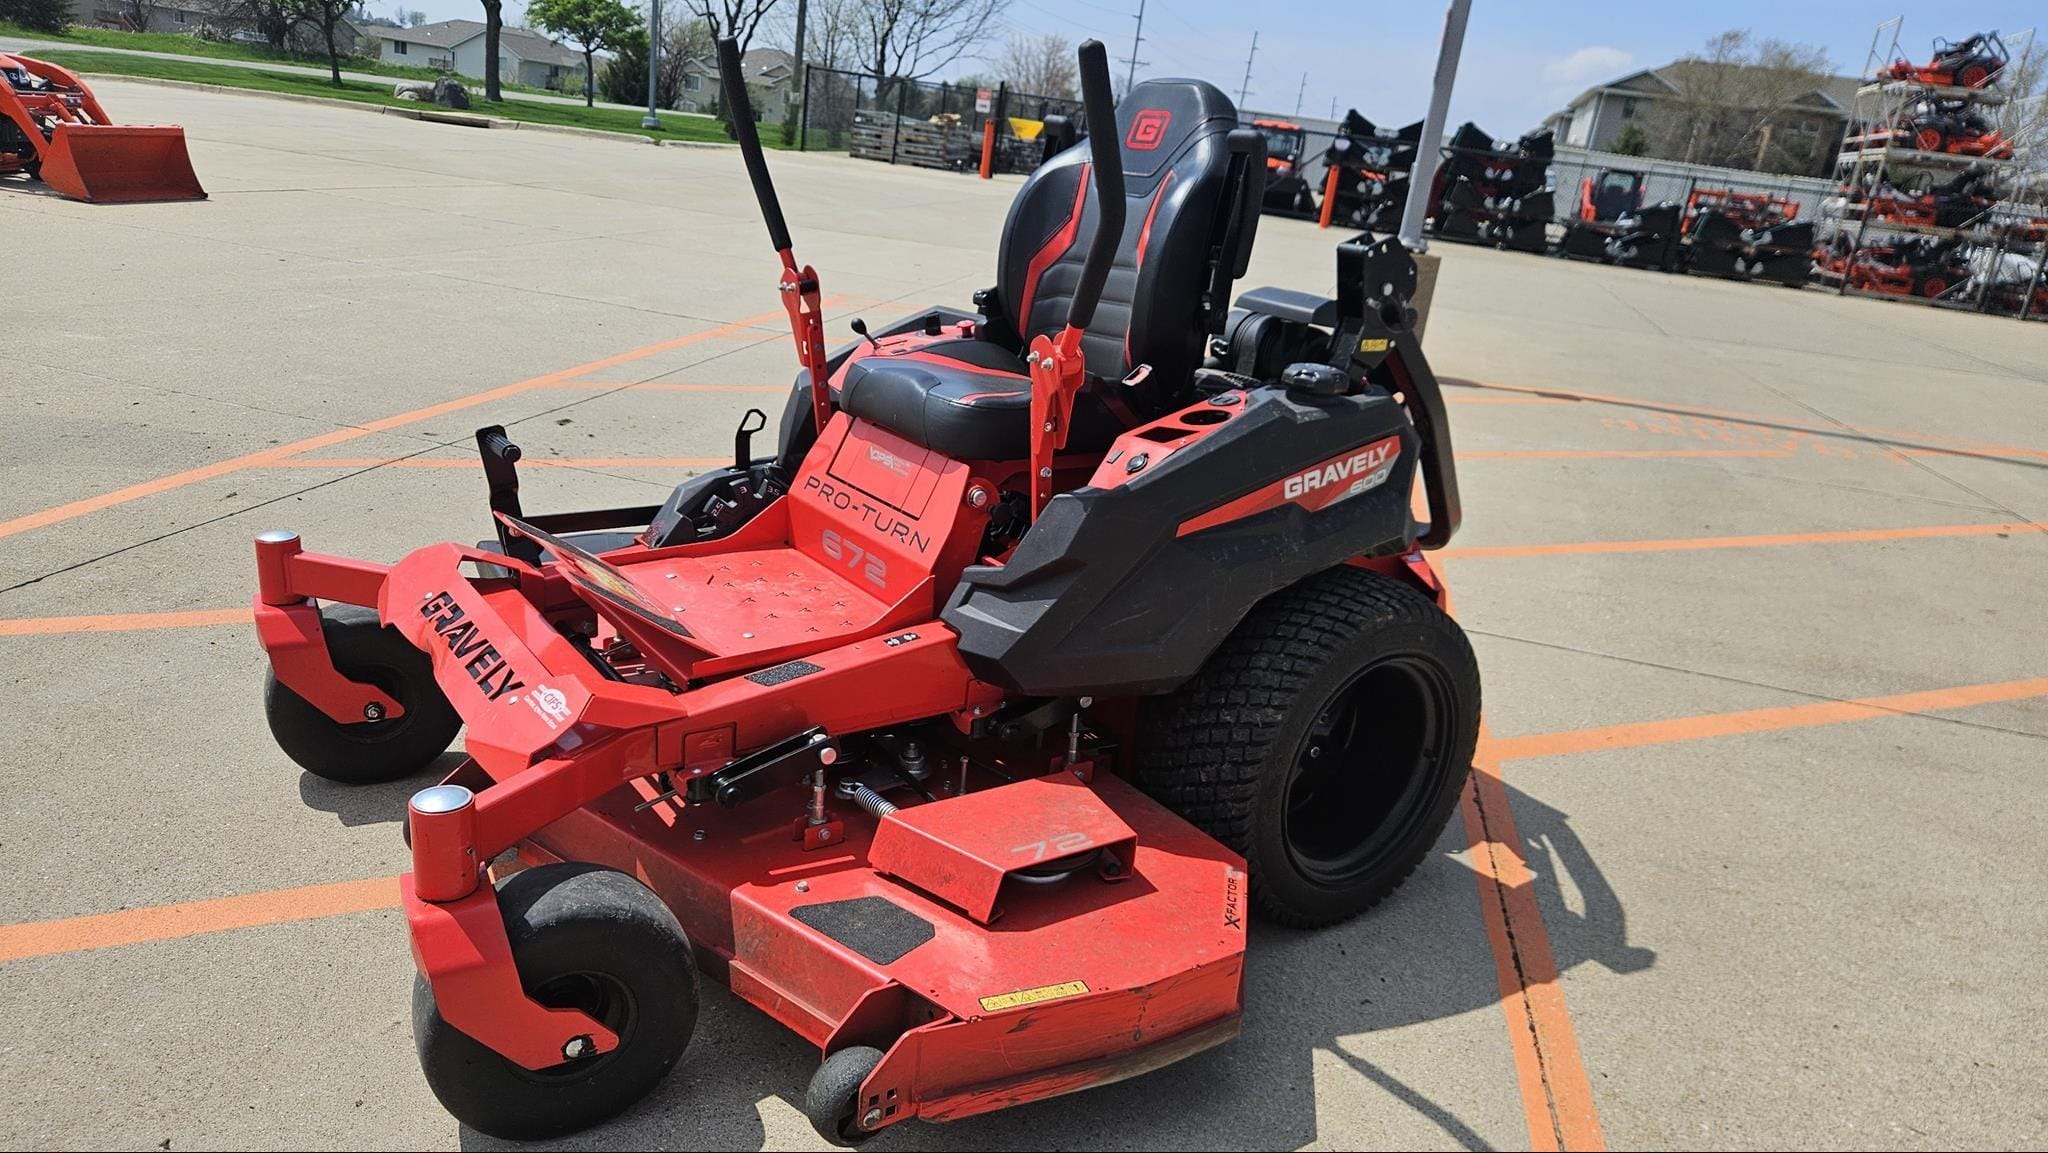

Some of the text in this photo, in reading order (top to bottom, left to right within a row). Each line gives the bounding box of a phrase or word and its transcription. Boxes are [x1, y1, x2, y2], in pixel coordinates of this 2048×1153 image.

[739, 486, 748, 494] 3
[1284, 442, 1392, 499] GRAVELY
[1350, 468, 1387, 494] 600
[804, 475, 930, 553] PRO-TURN
[822, 529, 887, 589] 672
[420, 591, 525, 702] GRAVELY
[543, 692, 562, 711] CIFS
[1010, 832, 1095, 860] 72
[1224, 877, 1241, 930] X-FACTOR
